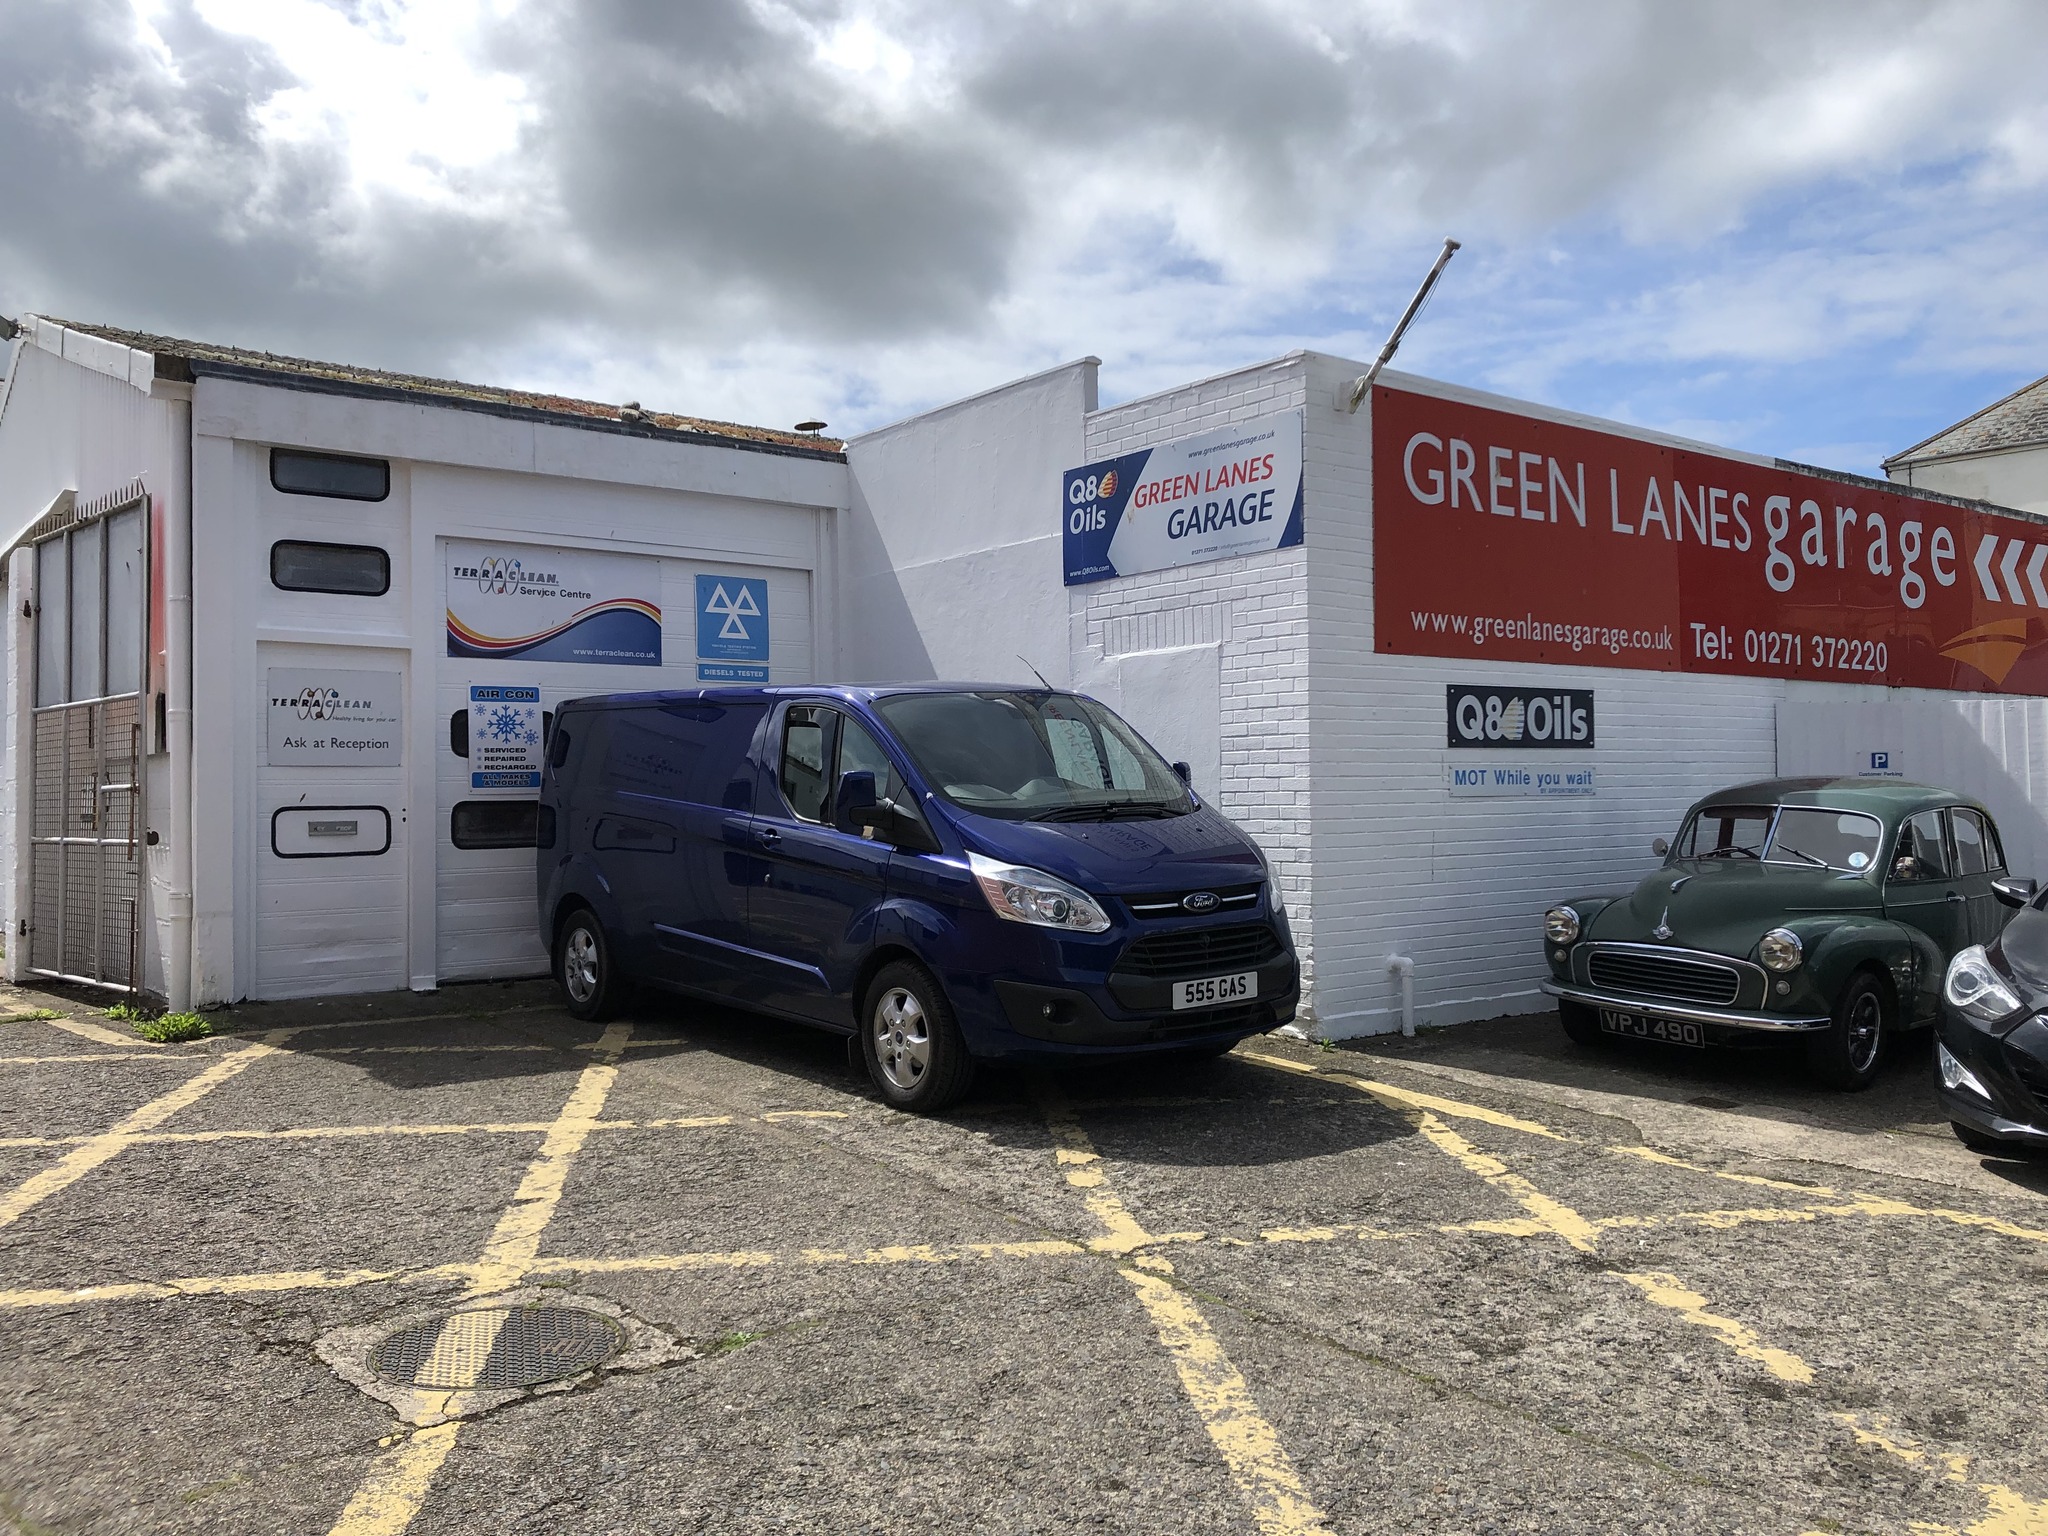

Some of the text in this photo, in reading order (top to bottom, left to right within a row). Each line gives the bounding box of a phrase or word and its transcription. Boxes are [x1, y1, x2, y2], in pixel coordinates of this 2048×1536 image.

[1188, 430, 1275, 459] www.greenlanesgarage.co.uk
[1069, 475, 1097, 505] Q8
[1134, 453, 1274, 509] GREEN LANES
[1069, 504, 1107, 535] Oils
[1167, 489, 1276, 540] GARAGE
[1404, 432, 1956, 609] GREEN LANES garage
[520, 586, 592, 599] Service Centre
[572, 648, 656, 659] www.terraclean.co.uk
[1410, 611, 1888, 673] www.greenlanesgarage.co.uk Tel: 01271 372220
[704, 668, 734, 676] DIESELS
[272, 698, 372, 709] TERRACLEAN
[476, 690, 534, 699] AIR CON
[1455, 694, 1588, 741] Q8 Oils
[283, 737, 389, 752] Ask at Reception
[1455, 769, 1592, 788] MOT While you wait
[1193, 894, 1214, 908] Ford
[1185, 975, 1247, 1004] 555 GAS
[1604, 1010, 1698, 1044] VPJ 490
